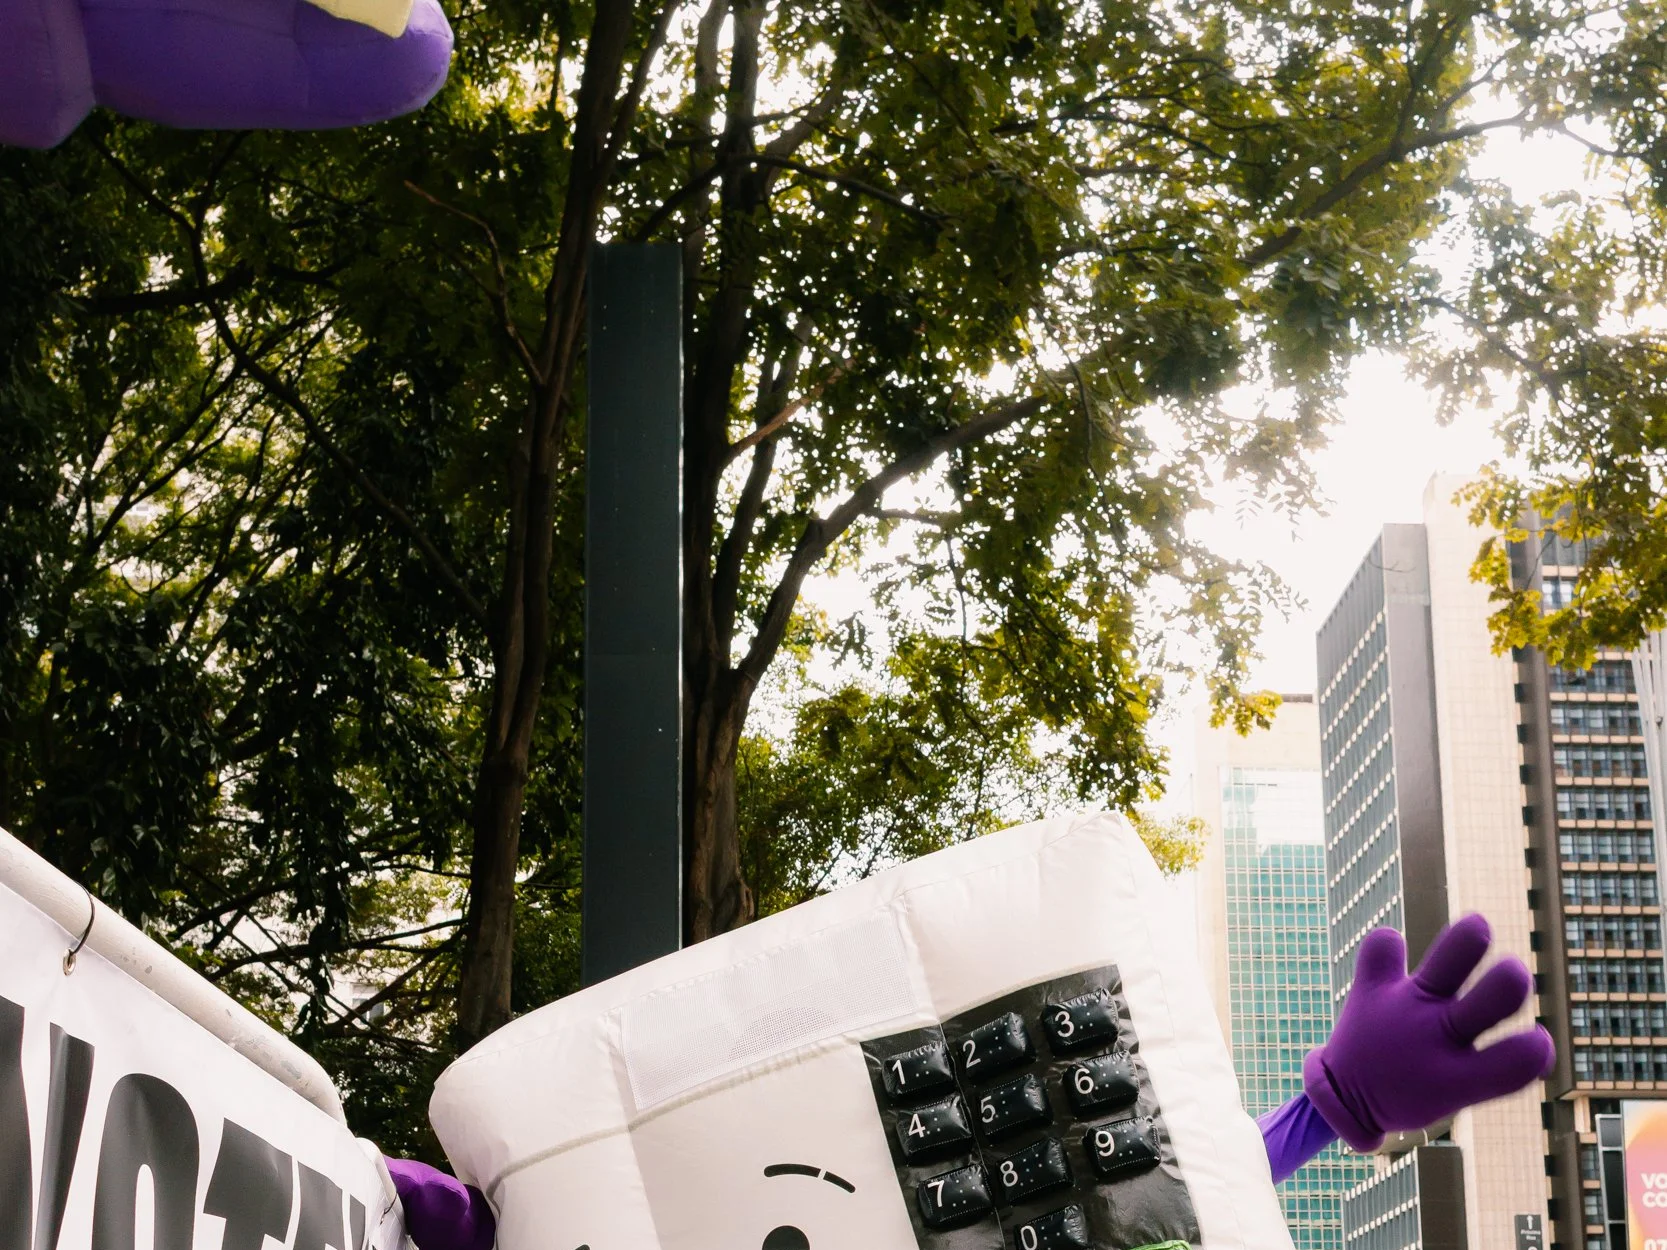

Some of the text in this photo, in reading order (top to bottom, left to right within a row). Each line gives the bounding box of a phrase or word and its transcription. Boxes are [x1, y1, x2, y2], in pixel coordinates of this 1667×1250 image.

[891, 1010, 1075, 1085] 1 2 3
[908, 1067, 1095, 1138] 4 5 6
[927, 1130, 1115, 1208] 7 8 9
